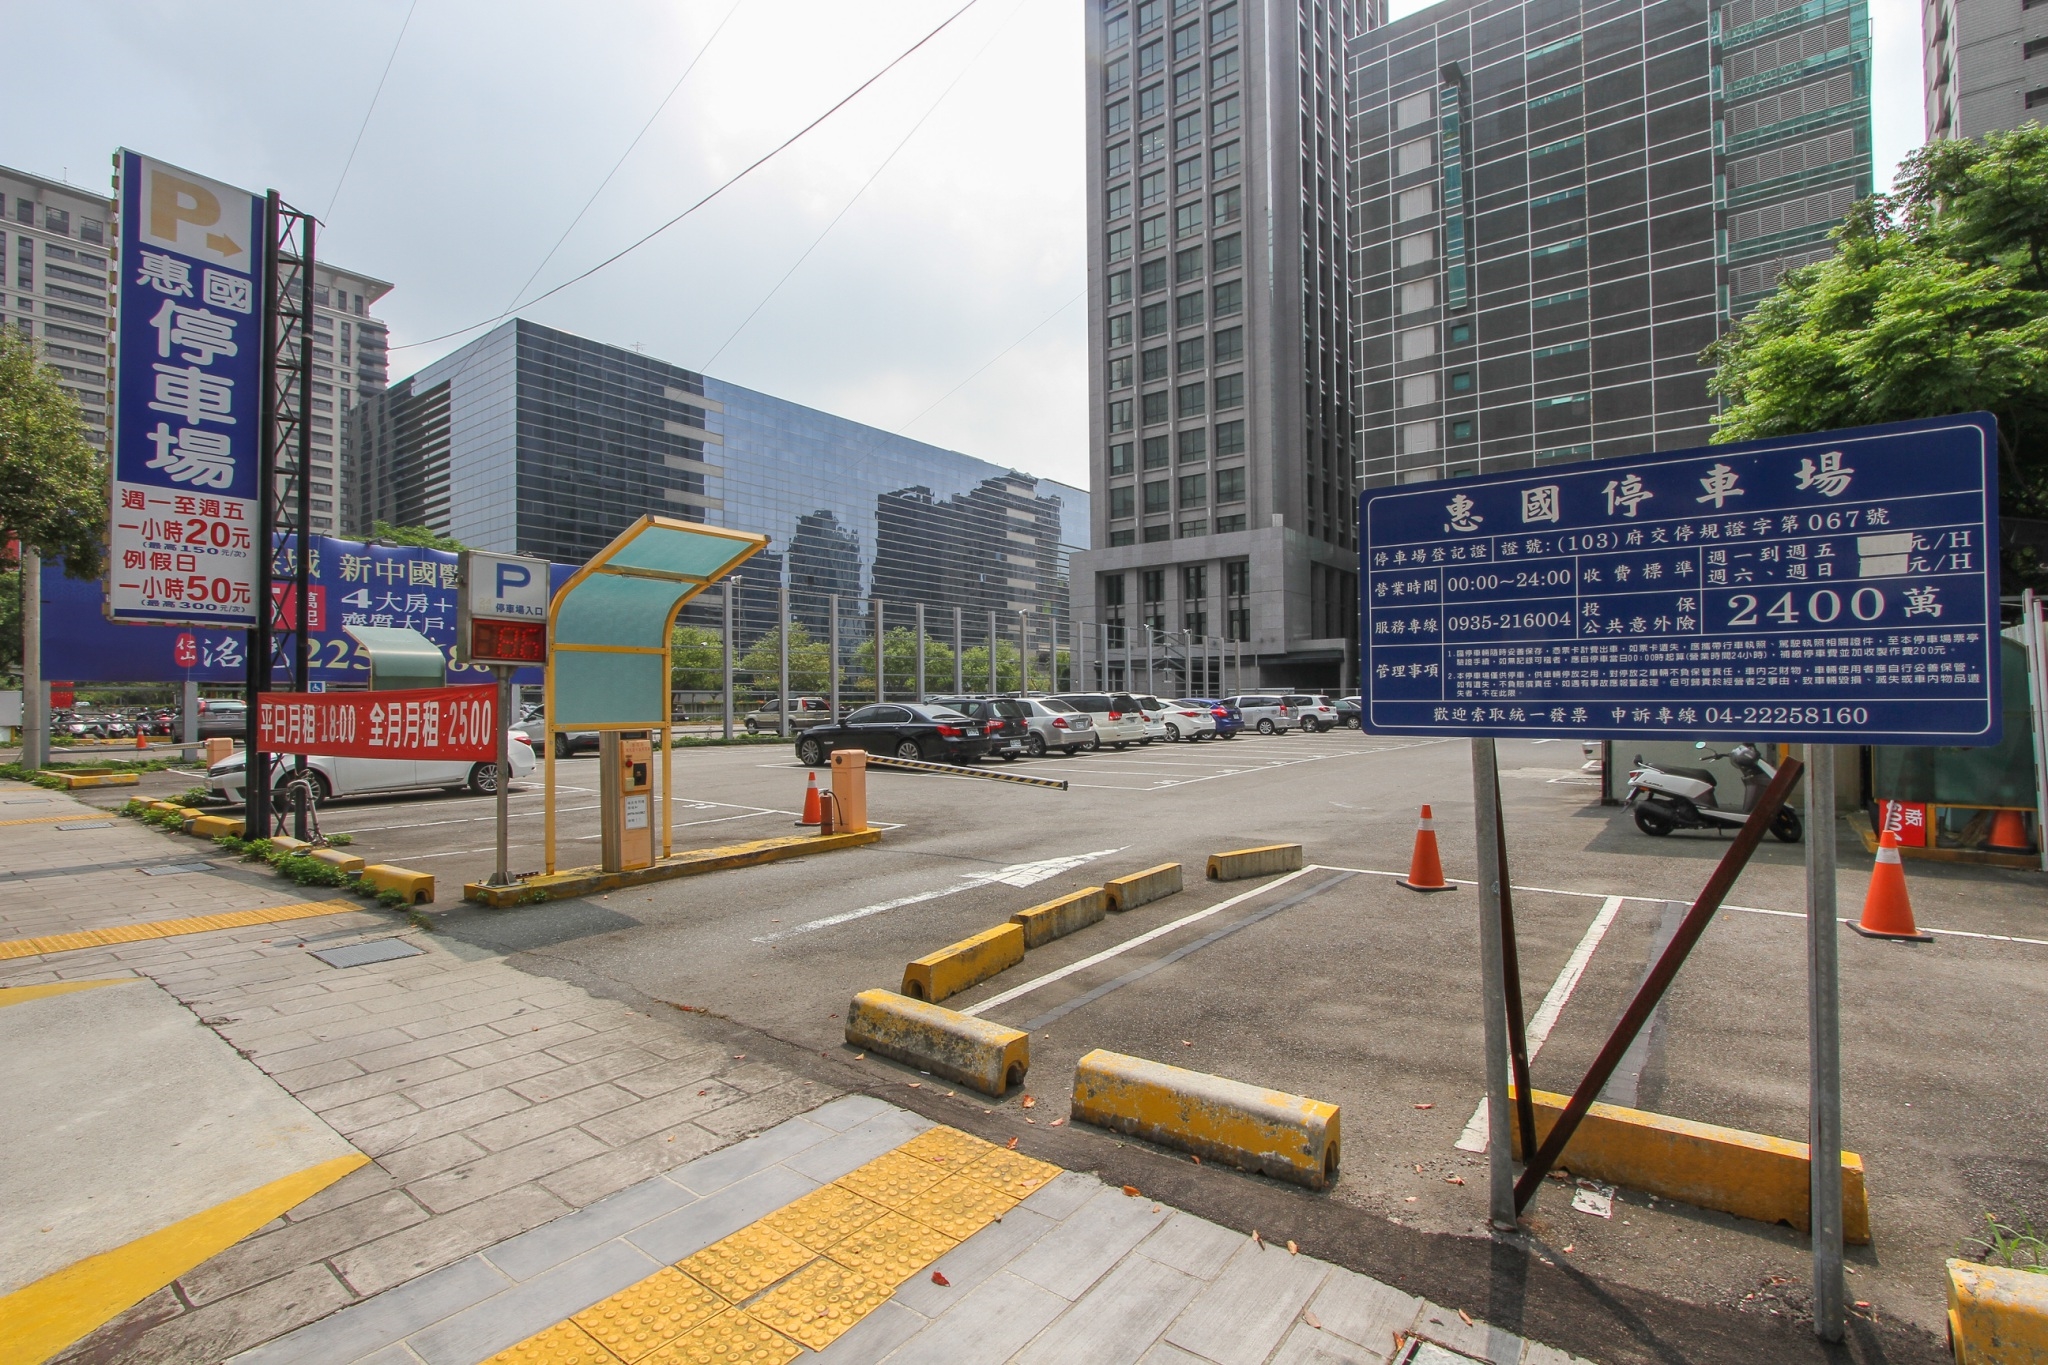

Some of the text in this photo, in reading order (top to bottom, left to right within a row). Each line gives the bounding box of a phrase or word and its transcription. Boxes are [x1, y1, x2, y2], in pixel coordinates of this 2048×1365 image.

[151, 169, 221, 243] P
[136, 250, 252, 315] 惠國
[146, 298, 238, 489] 停車場
[1444, 451, 1855, 533] 惠國停車場
[121, 488, 245, 520] 週一至週五
[118, 518, 251, 549] 一小時20元
[123, 549, 196, 572] 例假日
[1373, 544, 1488, 566] 停車場登記證
[1707, 542, 1836, 566] 週一到週五
[1908, 552, 1972, 573] 元/H
[496, 562, 532, 599] P
[1447, 569, 1571, 592] 00:00~24:00
[1583, 561, 1694, 584] 收費標準
[119, 576, 251, 604] 一小時50元
[1374, 579, 1438, 598] 營業時間
[495, 602, 543, 616] 停車場入口
[1374, 620, 1440, 635] 服務專線
[1448, 612, 1572, 631] 0935-216004
[1582, 615, 1696, 634] 公共意外險
[496, 626, 540, 659] 86
[1375, 663, 1440, 679] 管理事項
[260, 699, 492, 748] 平日月租 1800 全月月租 2500
[1434, 707, 1868, 725] 歡迎索取統一發票 申訴專線 04-22258160
